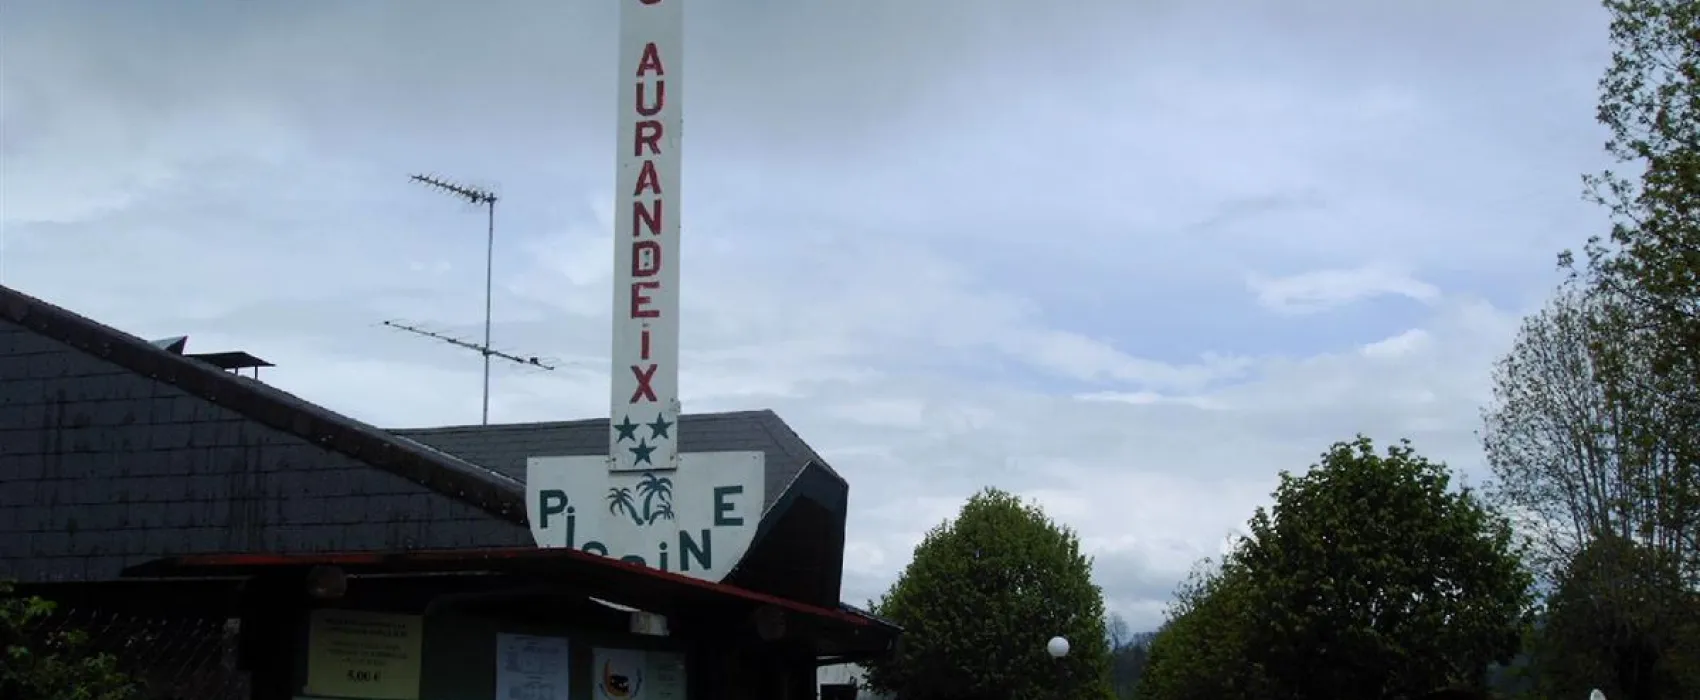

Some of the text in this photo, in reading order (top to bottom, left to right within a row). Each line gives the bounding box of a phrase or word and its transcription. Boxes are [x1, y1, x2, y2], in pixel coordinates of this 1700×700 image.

[630, 42, 665, 404] AURANDEIX
[539, 485, 744, 572] PiiNE
[346, 669, 371, 683] 5,00
